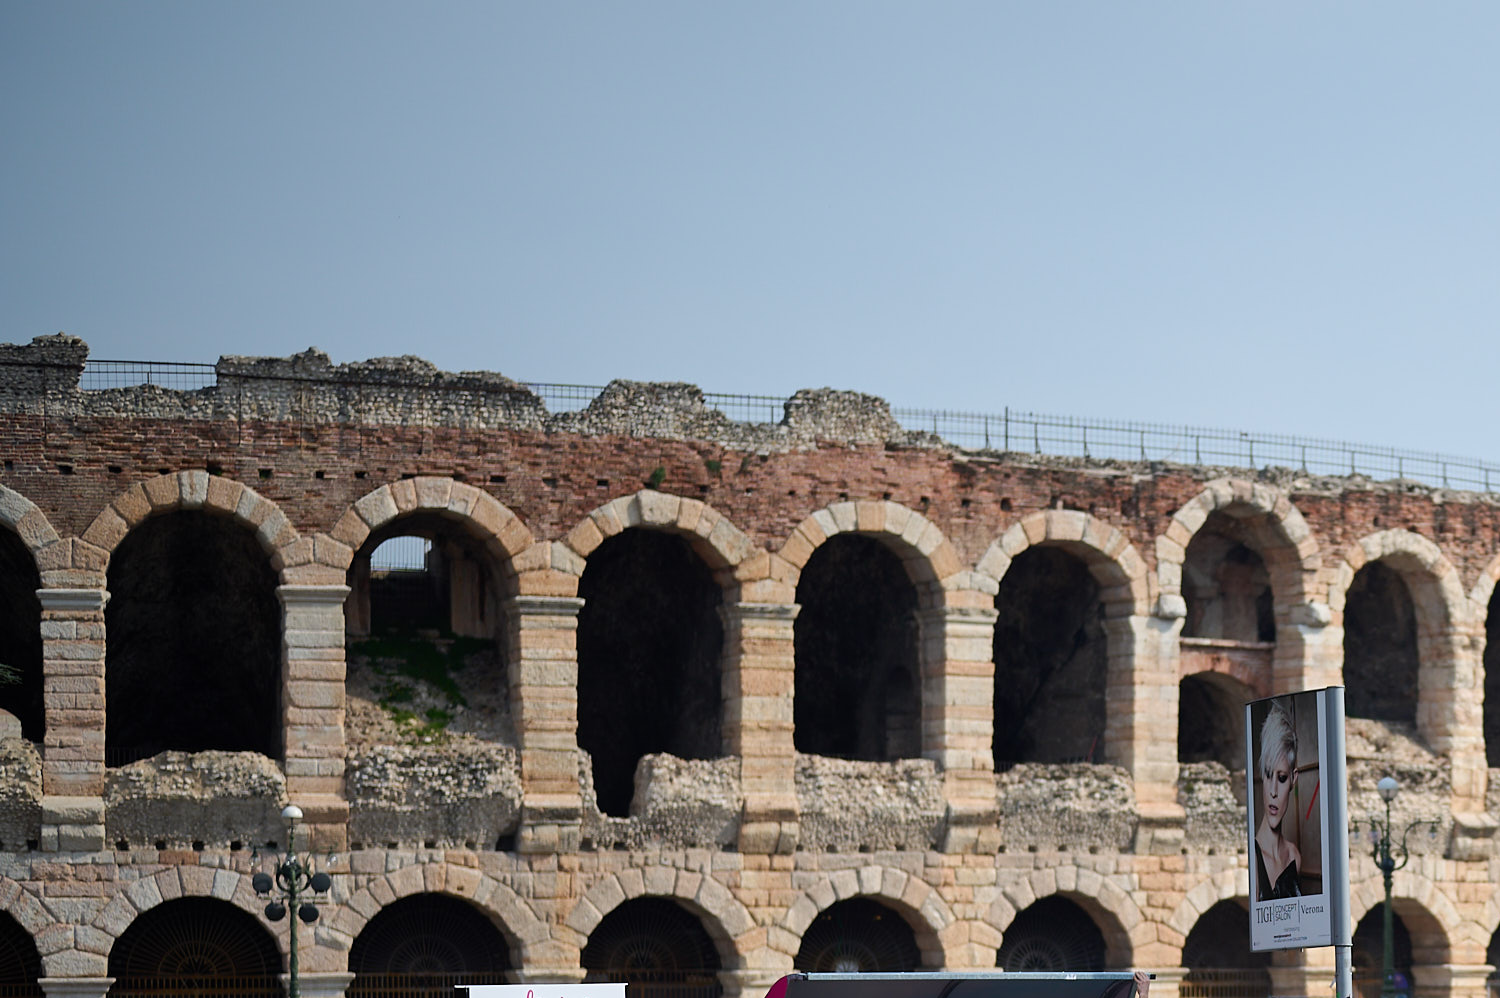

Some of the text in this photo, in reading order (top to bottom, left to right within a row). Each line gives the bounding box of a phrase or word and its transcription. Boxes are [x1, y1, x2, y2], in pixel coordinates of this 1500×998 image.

[1256, 903, 1324, 924] TIGI CONCEPT Verona
[1275, 913, 1291, 921] SALON
